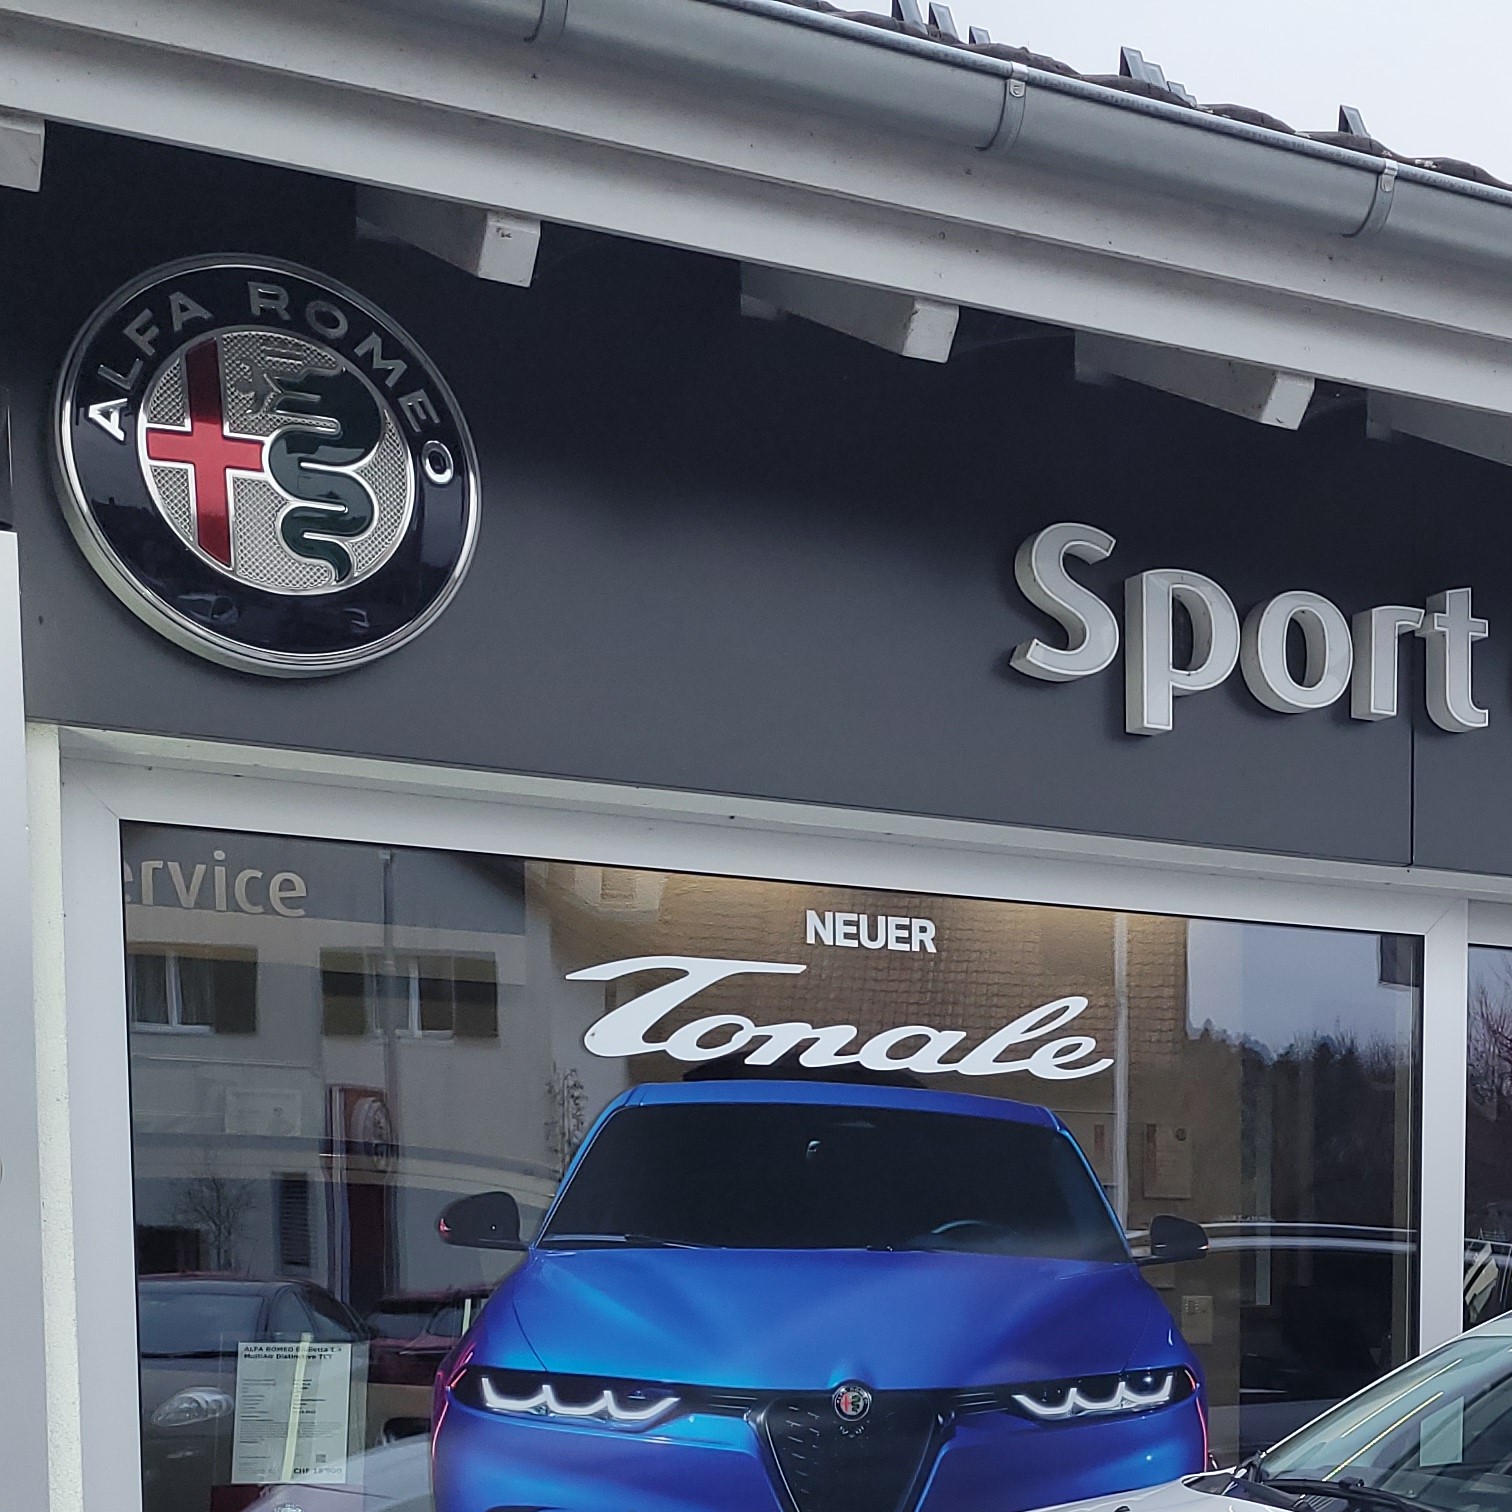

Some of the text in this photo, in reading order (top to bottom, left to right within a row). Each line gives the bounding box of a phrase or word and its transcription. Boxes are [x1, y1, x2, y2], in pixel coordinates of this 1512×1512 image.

[88, 281, 454, 485] ALFA ROMEO
[1009, 522, 1490, 736] Sport
[806, 910, 937, 953] NEUER
[565, 954, 1114, 1080] Tonale
